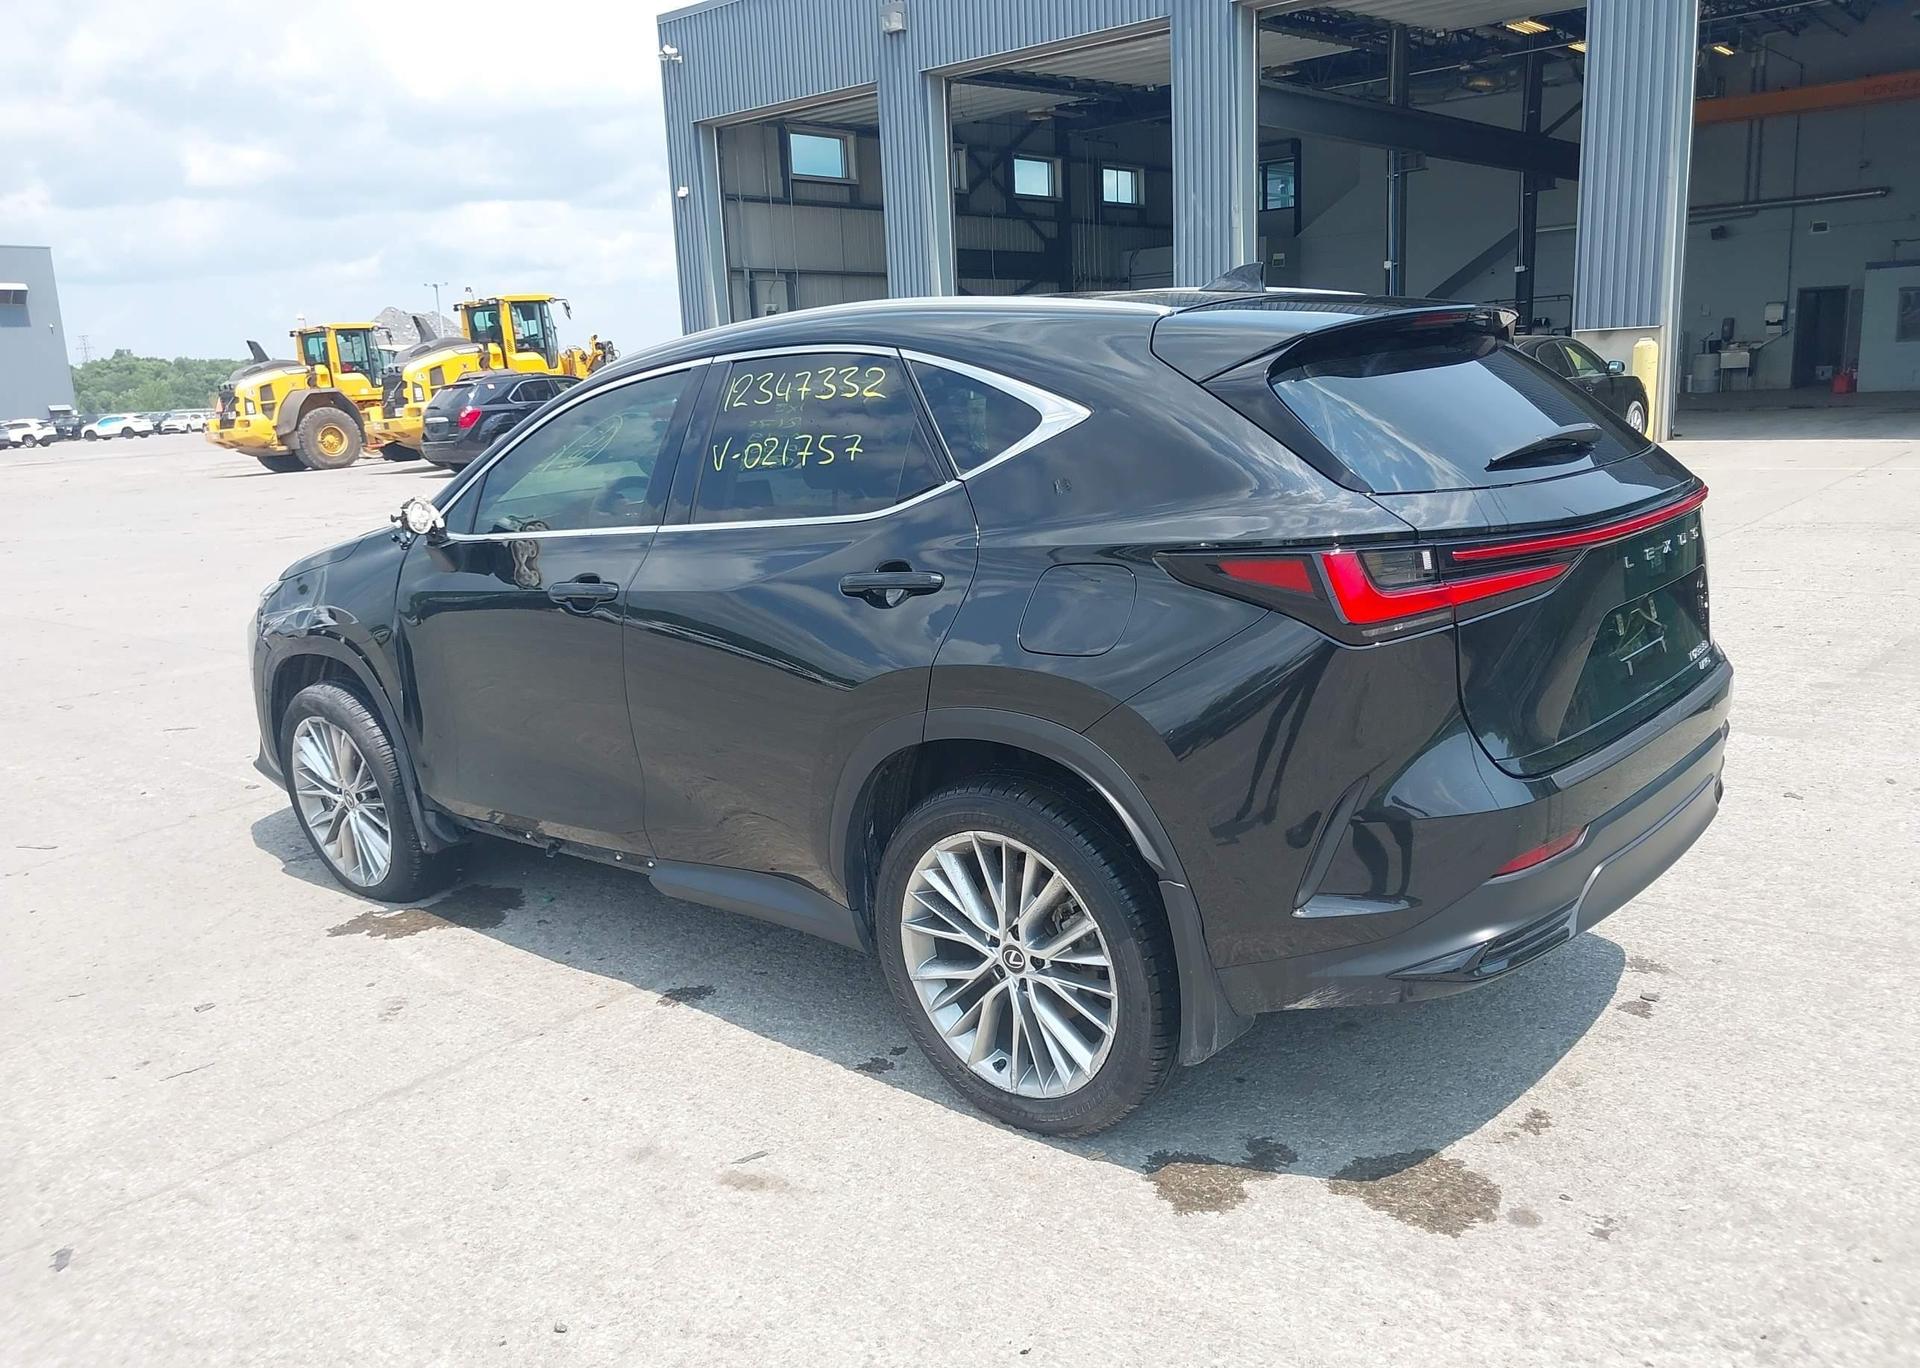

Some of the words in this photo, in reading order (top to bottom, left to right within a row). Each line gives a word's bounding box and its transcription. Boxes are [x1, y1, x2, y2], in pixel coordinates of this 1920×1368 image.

[724, 367, 886, 411] 12347332
[713, 434, 863, 471] V-021757
[1624, 527, 1699, 568] LEXUS
